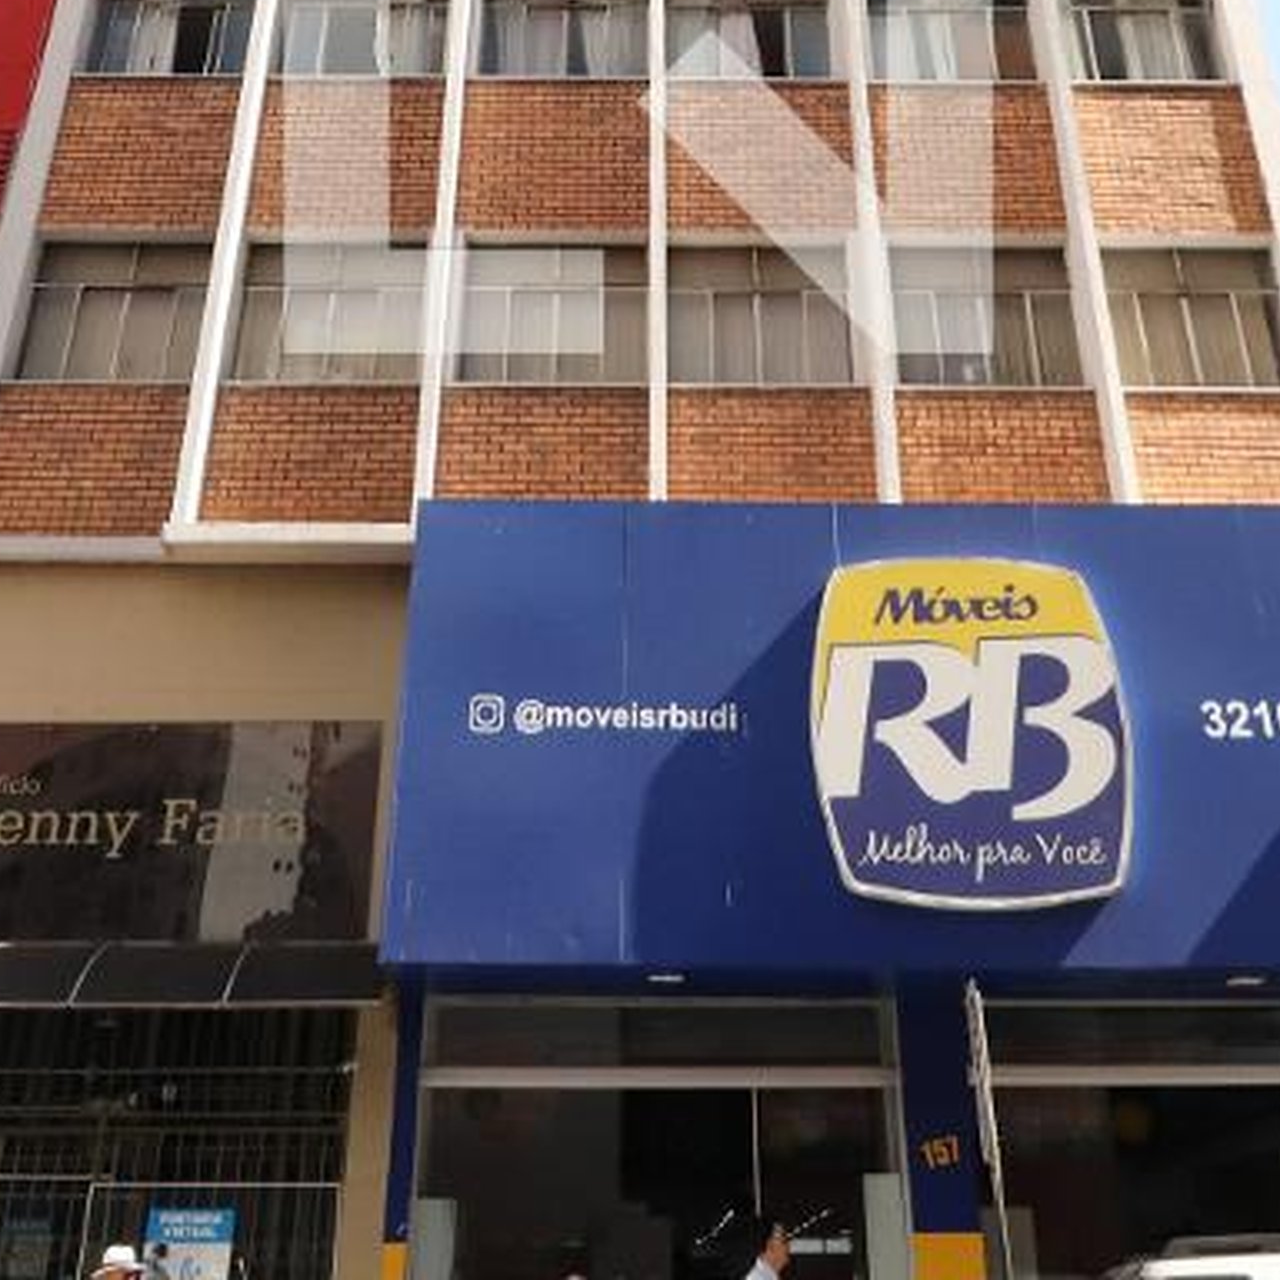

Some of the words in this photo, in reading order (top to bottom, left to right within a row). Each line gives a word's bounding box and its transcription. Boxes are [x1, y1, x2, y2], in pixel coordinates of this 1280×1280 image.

[874, 584, 1039, 626] Móveis
[514, 698, 738, 735] @moveisrbudi
[820, 634, 1117, 821] RB
[857, 822, 971, 866] Melhor
[972, 836, 1033, 883] pra
[1034, 834, 1107, 866] Você
[920, 1135, 959, 1169] 157
